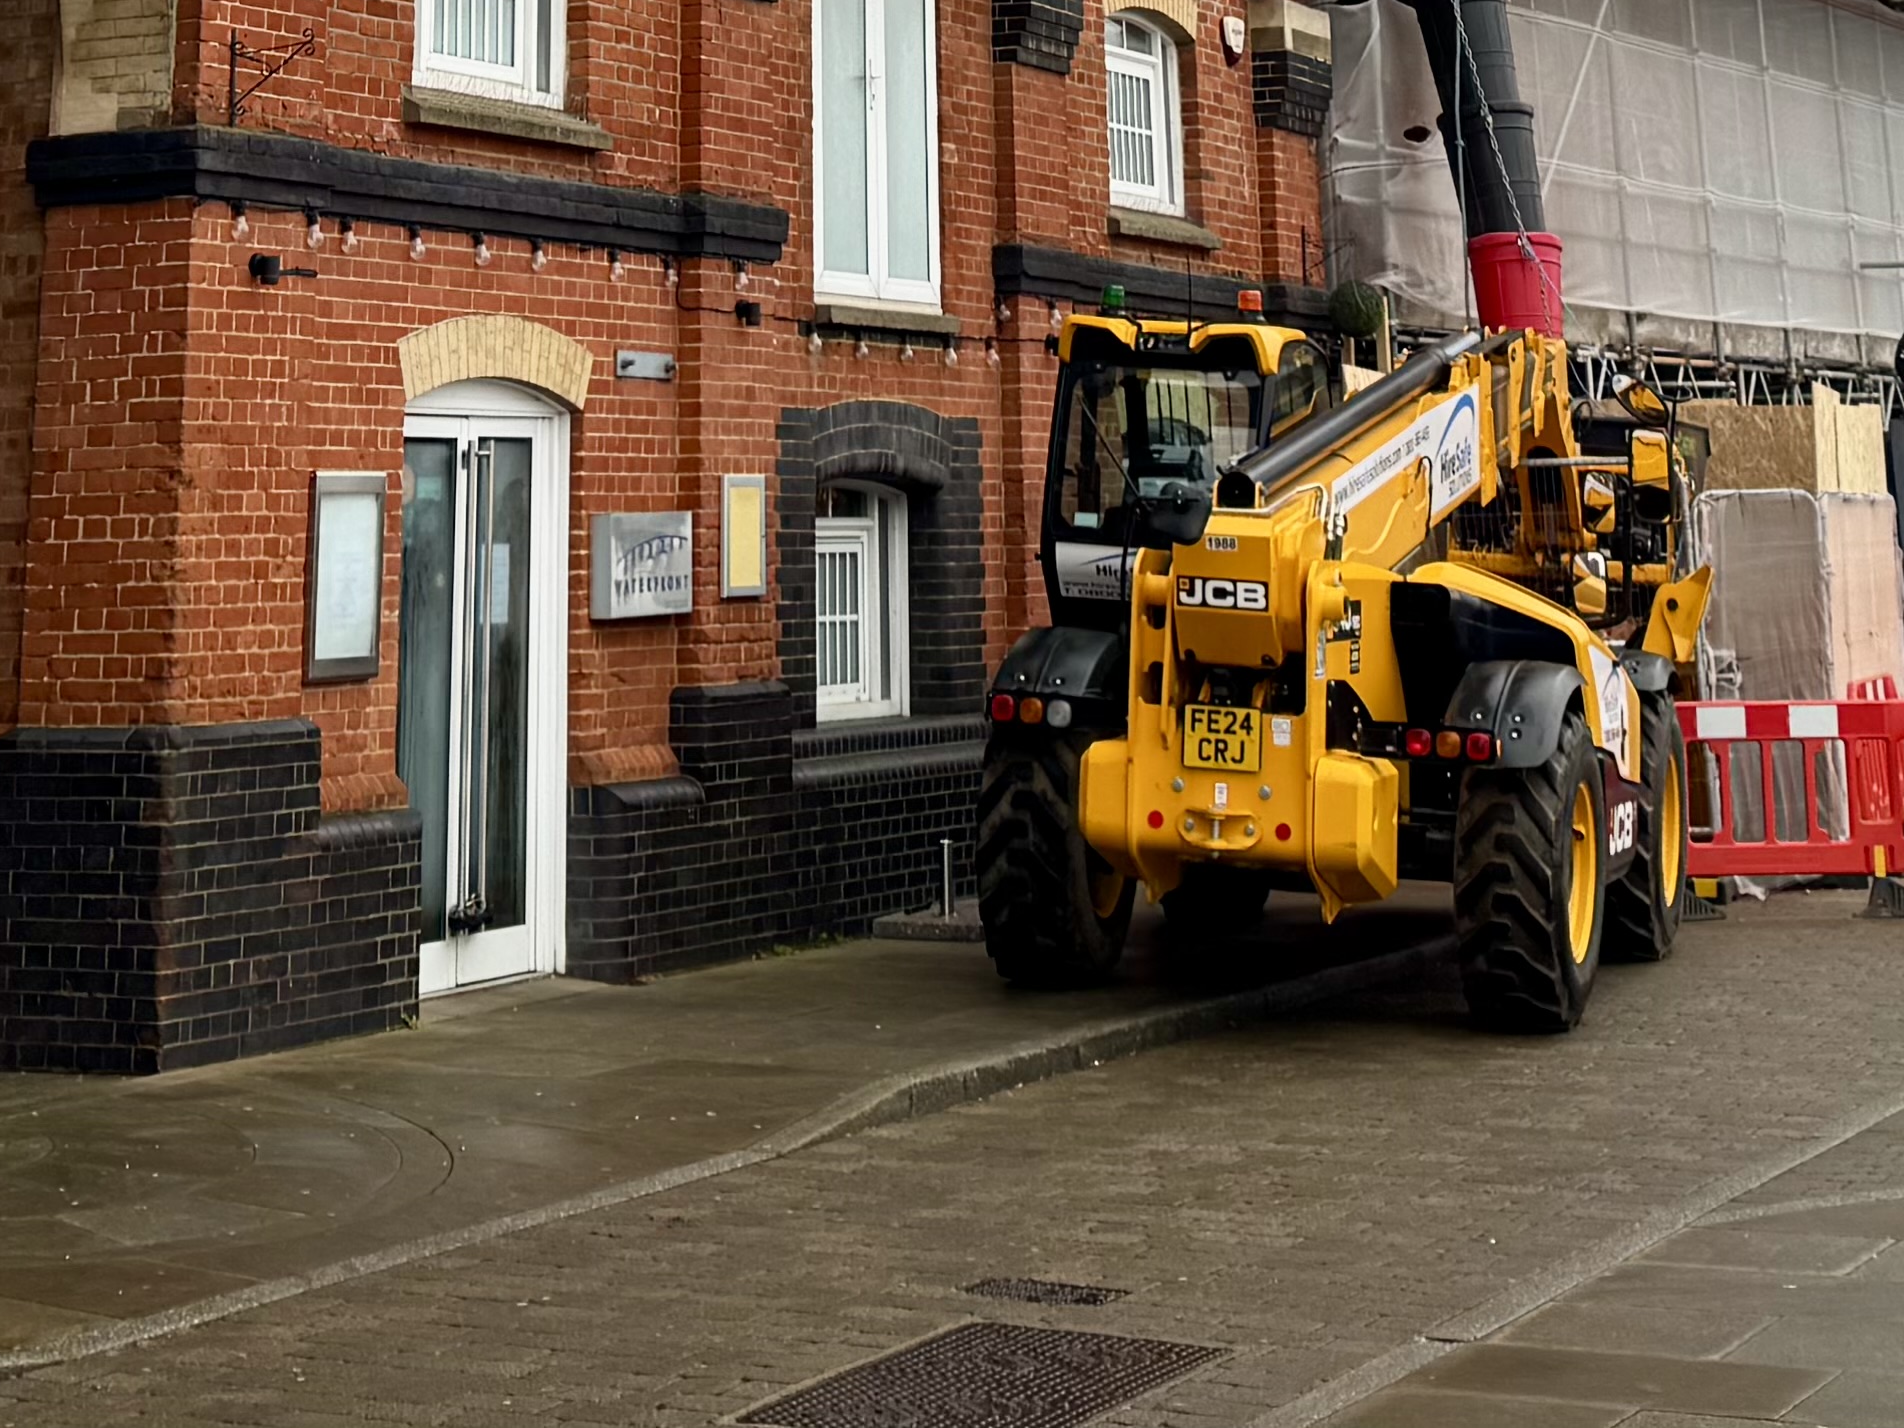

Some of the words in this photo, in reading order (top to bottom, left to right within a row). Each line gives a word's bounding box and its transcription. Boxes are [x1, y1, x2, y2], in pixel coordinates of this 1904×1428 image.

[1208, 537, 1237, 549] 1988
[614, 575, 688, 595] WATERFRONT
[1178, 578, 1267, 609] JCB
[1191, 708, 1253, 735] FE24
[1198, 738, 1245, 763] CRJ
[1609, 800, 1633, 856] JCB
